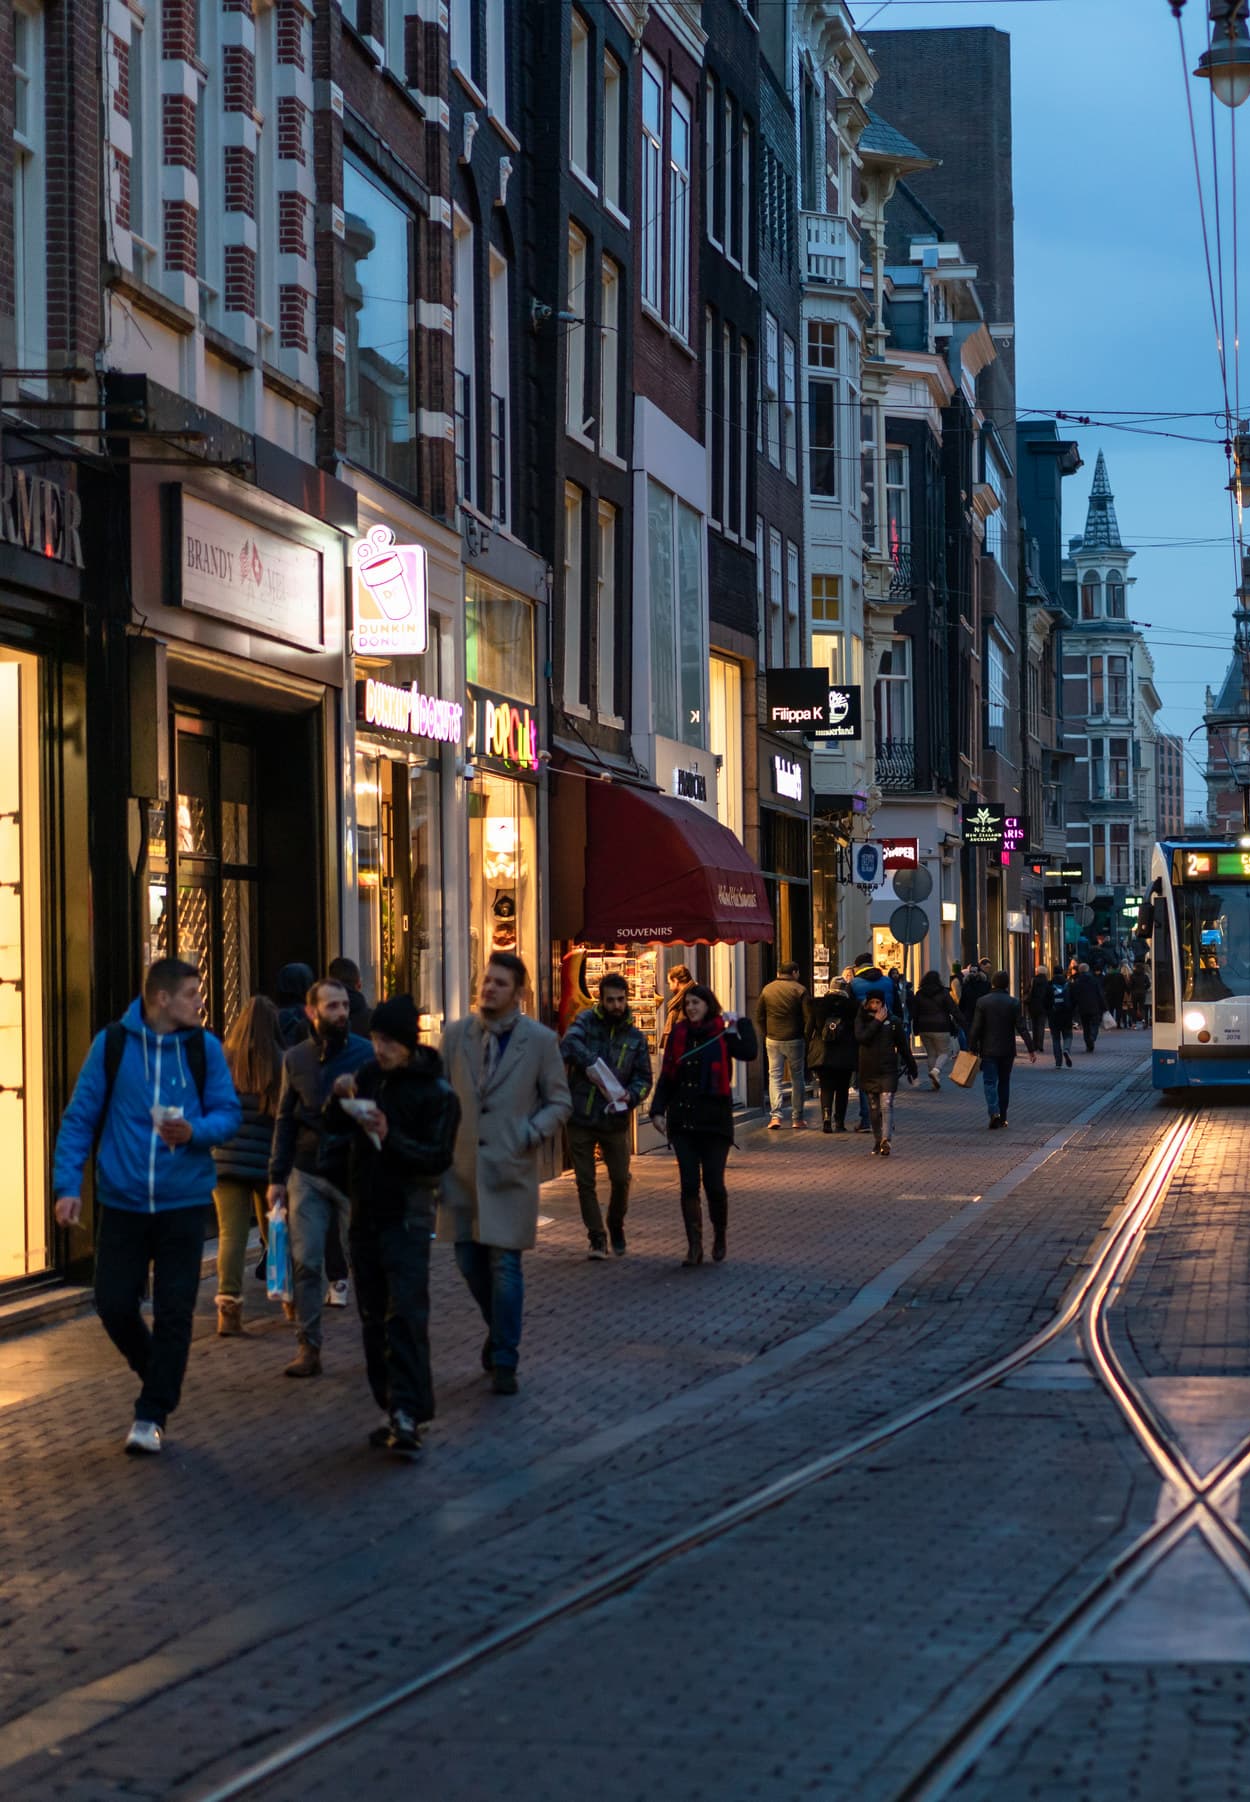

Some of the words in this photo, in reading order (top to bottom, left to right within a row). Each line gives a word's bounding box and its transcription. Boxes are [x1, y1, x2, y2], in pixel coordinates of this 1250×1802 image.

[187, 536, 233, 582] BRANDY
[359, 624, 416, 635] DUNKIN
[359, 636, 416, 647] DONUS
[419, 694, 463, 743] DONUTS
[772, 707, 811, 723] Filippa
[813, 706, 823, 720] K
[1005, 818, 1017, 827] CI
[1004, 829, 1024, 839] ARIS
[1188, 854, 1198, 876] 2
[617, 927, 672, 937] SOUVENIRS
